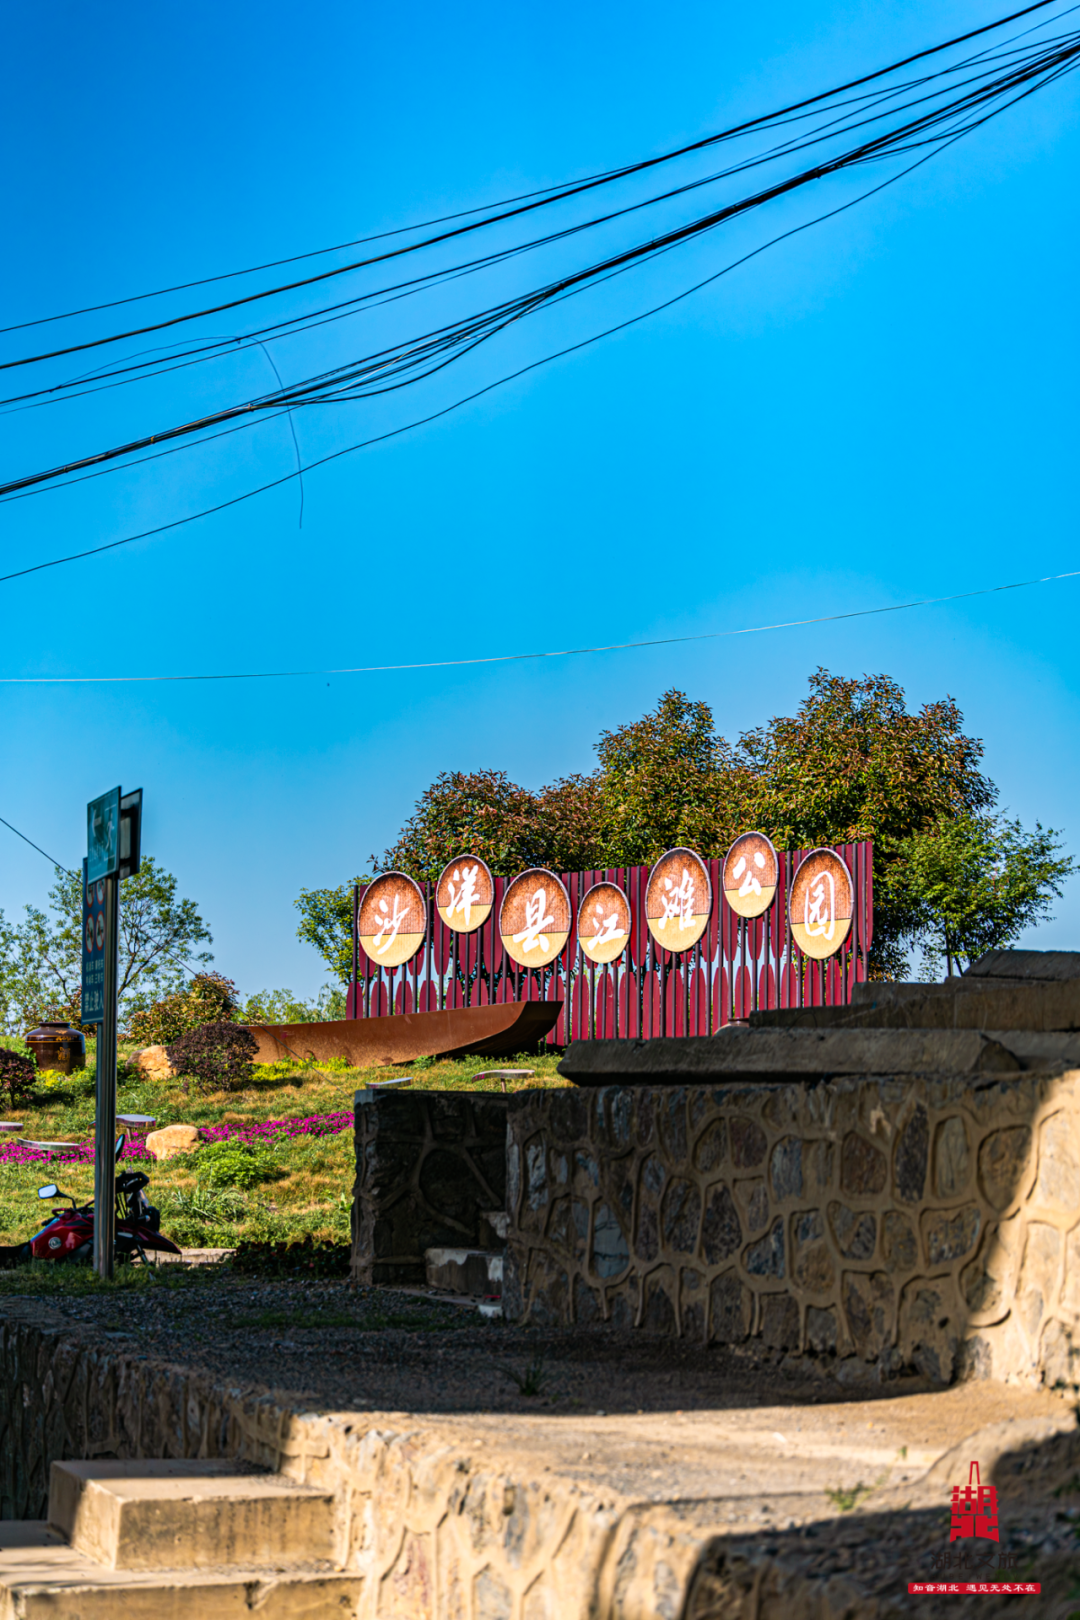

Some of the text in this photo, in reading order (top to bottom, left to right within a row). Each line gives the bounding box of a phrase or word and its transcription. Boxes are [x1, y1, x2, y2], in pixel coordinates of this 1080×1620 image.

[373, 851, 836, 956] 沙洋县江滩公园
